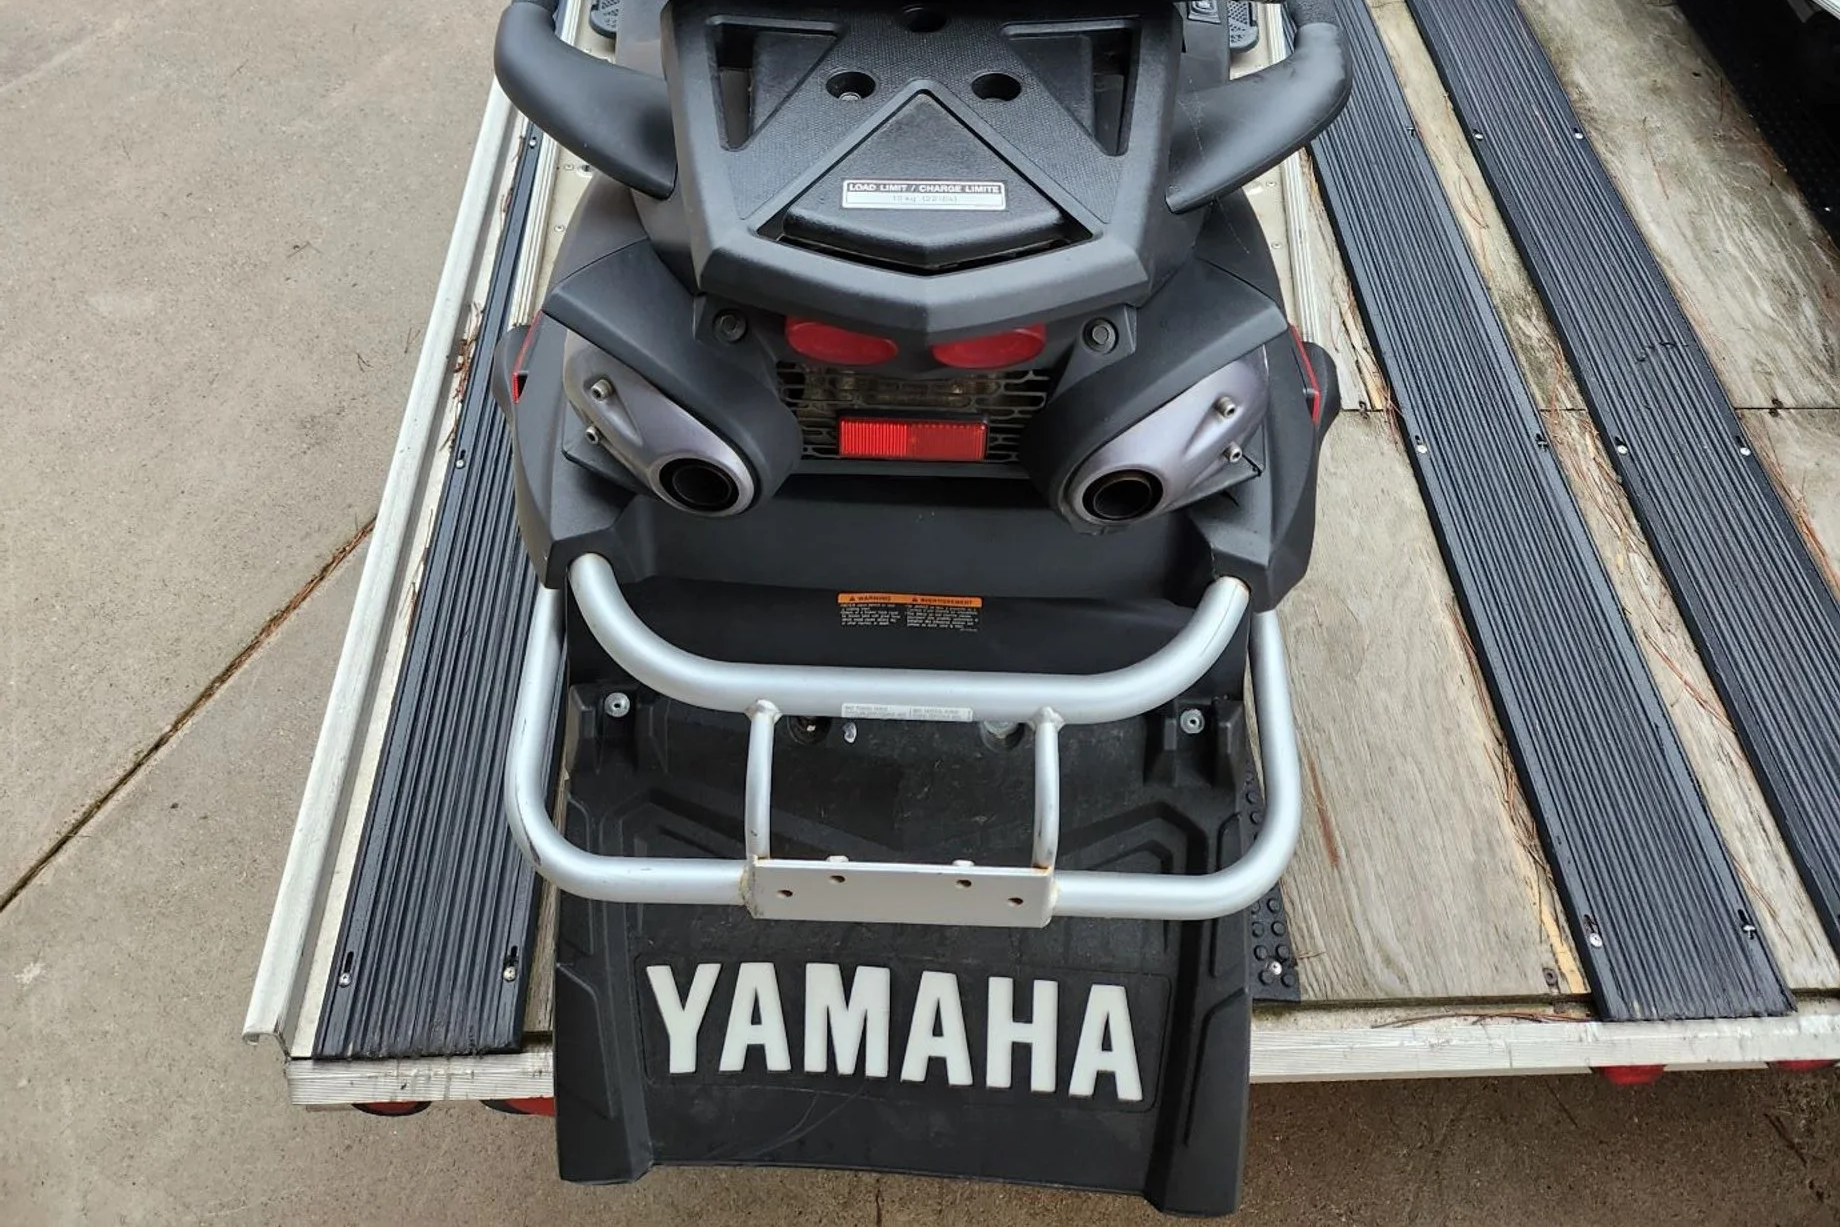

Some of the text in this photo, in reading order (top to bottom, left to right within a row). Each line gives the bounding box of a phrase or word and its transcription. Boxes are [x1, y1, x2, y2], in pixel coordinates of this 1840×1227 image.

[849, 183, 876, 192] LOAD
[880, 183, 907, 192] LIMIT
[919, 184, 962, 193] CHARGE
[965, 185, 999, 193] LIMITE
[645, 961, 1143, 1102] YAMAHA
